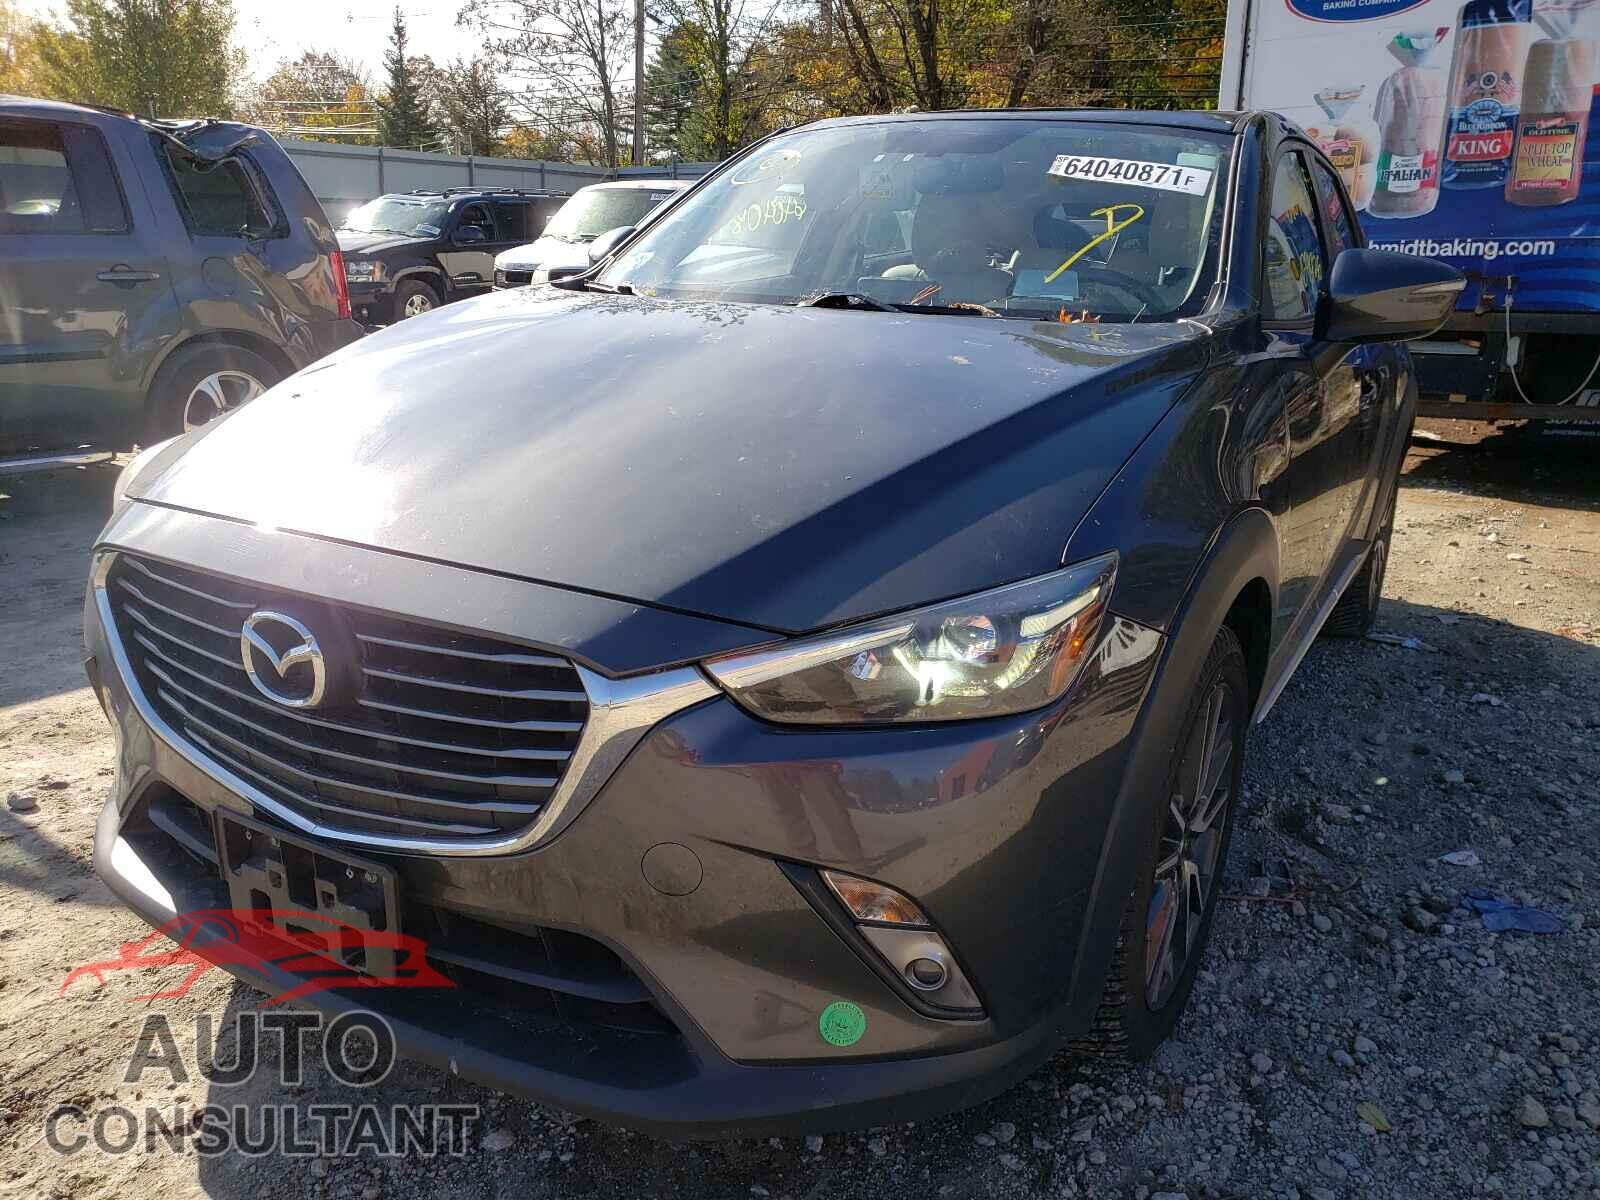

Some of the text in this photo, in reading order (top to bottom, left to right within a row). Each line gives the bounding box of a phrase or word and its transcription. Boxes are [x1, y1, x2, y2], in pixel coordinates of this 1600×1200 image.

[1456, 138, 1502, 155] KING
[1063, 157, 1184, 187] 64040871
[1184, 174, 1196, 187] F
[1380, 167, 1432, 182] ITALIAN
